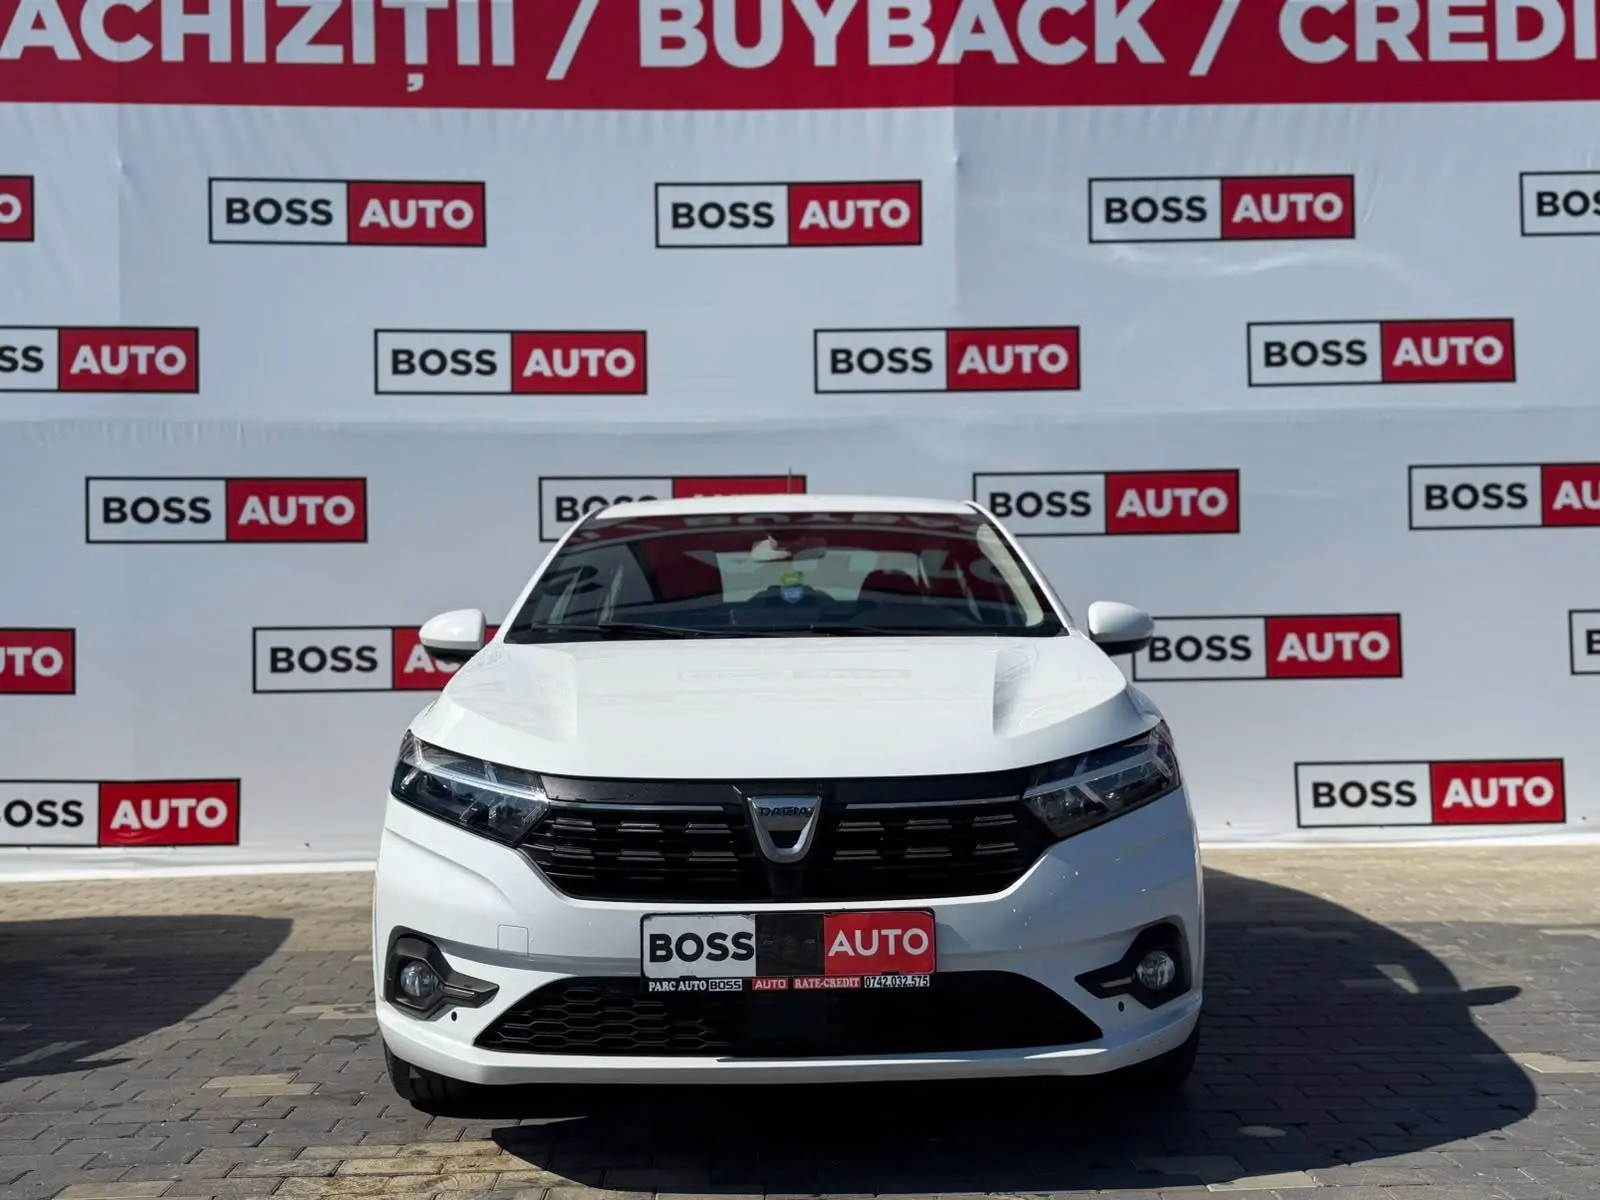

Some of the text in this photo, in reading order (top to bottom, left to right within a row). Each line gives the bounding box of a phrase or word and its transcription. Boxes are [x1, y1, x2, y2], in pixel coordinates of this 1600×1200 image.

[0, 0, 515, 92] ACHIZIȚII
[640, 0, 1165, 69] BUYBACK
[1278, 0, 1598, 64] CREDI
[226, 197, 474, 230] BOSS AUTO
[672, 198, 911, 229] BOSS AUTO
[1105, 192, 1343, 224] BOSS AUTO
[70, 345, 187, 375] AUTO
[391, 348, 636, 378] BOSS AUTO
[831, 344, 1069, 374] BOSS AUTO
[1264, 336, 1504, 368] BOSS AUTO
[103, 495, 355, 525] BOSS AUTO
[988, 487, 1228, 519] BOSS AUTO
[1425, 482, 1528, 511] BOSS
[270, 645, 378, 673] BOSS
[1147, 631, 1390, 663] BOSS AUTO
[1312, 776, 1554, 809] BOSS AUTO
[110, 797, 228, 830] AUTO
[649, 931, 755, 963] BOSS
[828, 927, 929, 957] AUTO
[648, 980, 676, 992] PARC
[678, 979, 707, 992] AUTO
[709, 979, 742, 991] BOSS
[753, 979, 786, 990] AUTO
[794, 976, 860, 989] RATE-CREDIT
